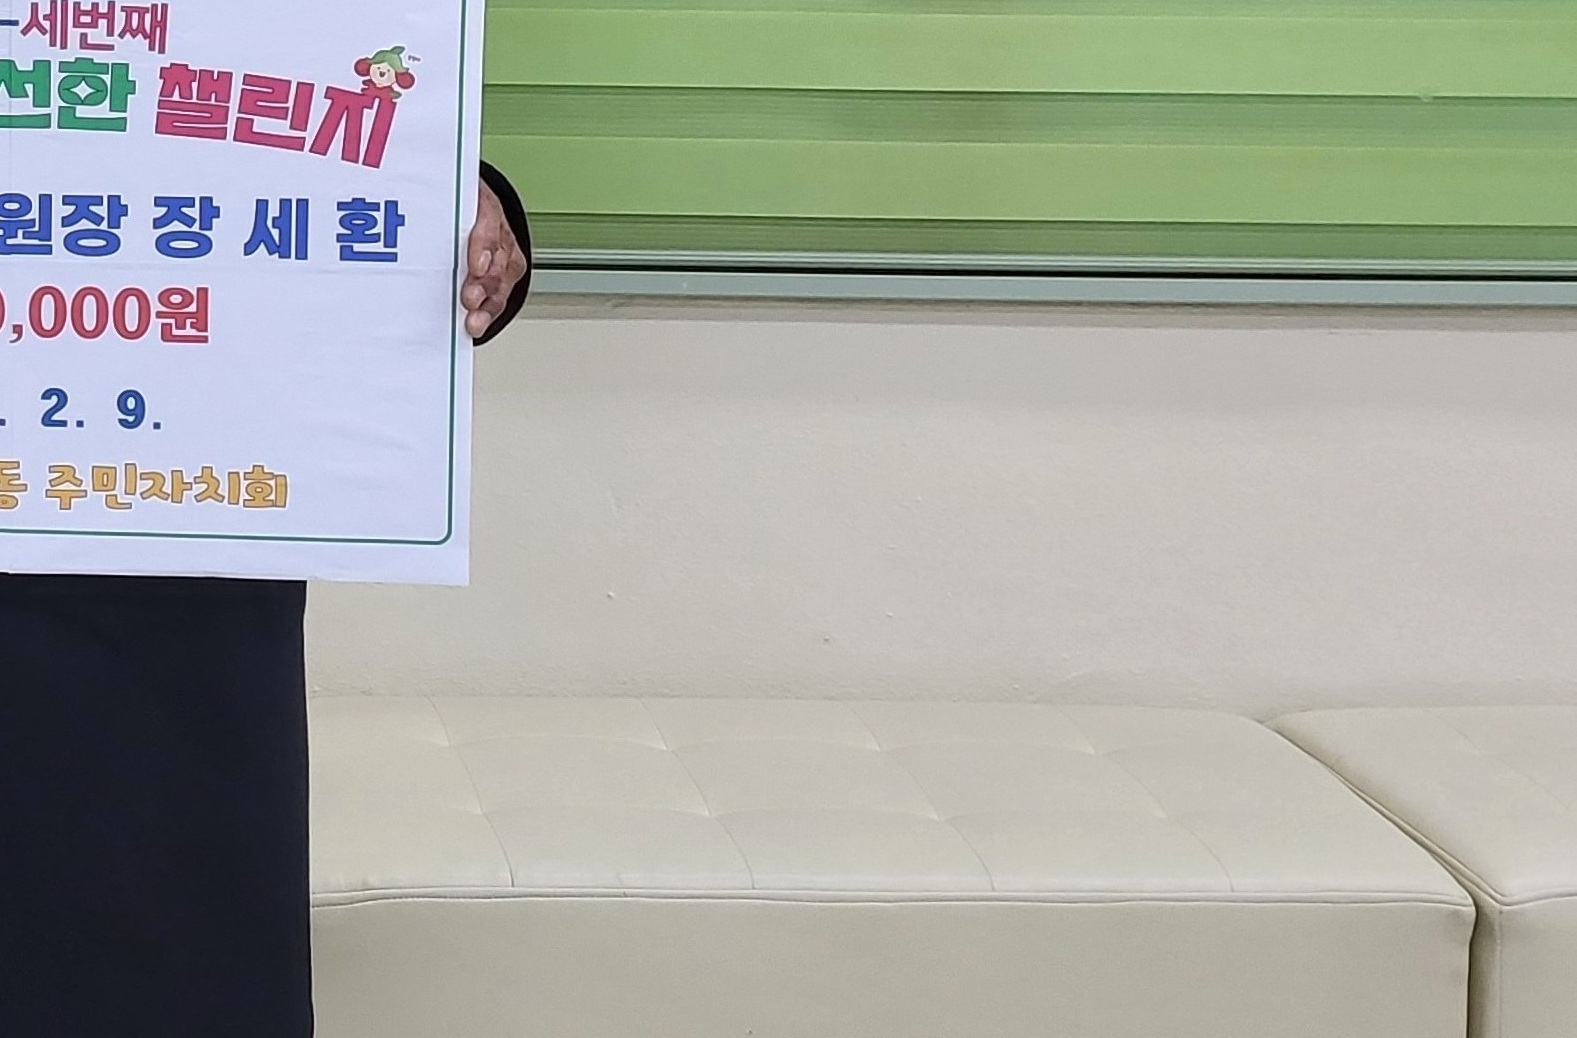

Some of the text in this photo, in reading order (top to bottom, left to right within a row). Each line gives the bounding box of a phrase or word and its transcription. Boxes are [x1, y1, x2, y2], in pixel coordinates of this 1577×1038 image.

[154, 62, 399, 168] 챌린지
[40, 387, 85, 428] 2.
[116, 389, 162, 430] 9.
[44, 462, 289, 511] 주민자치회
